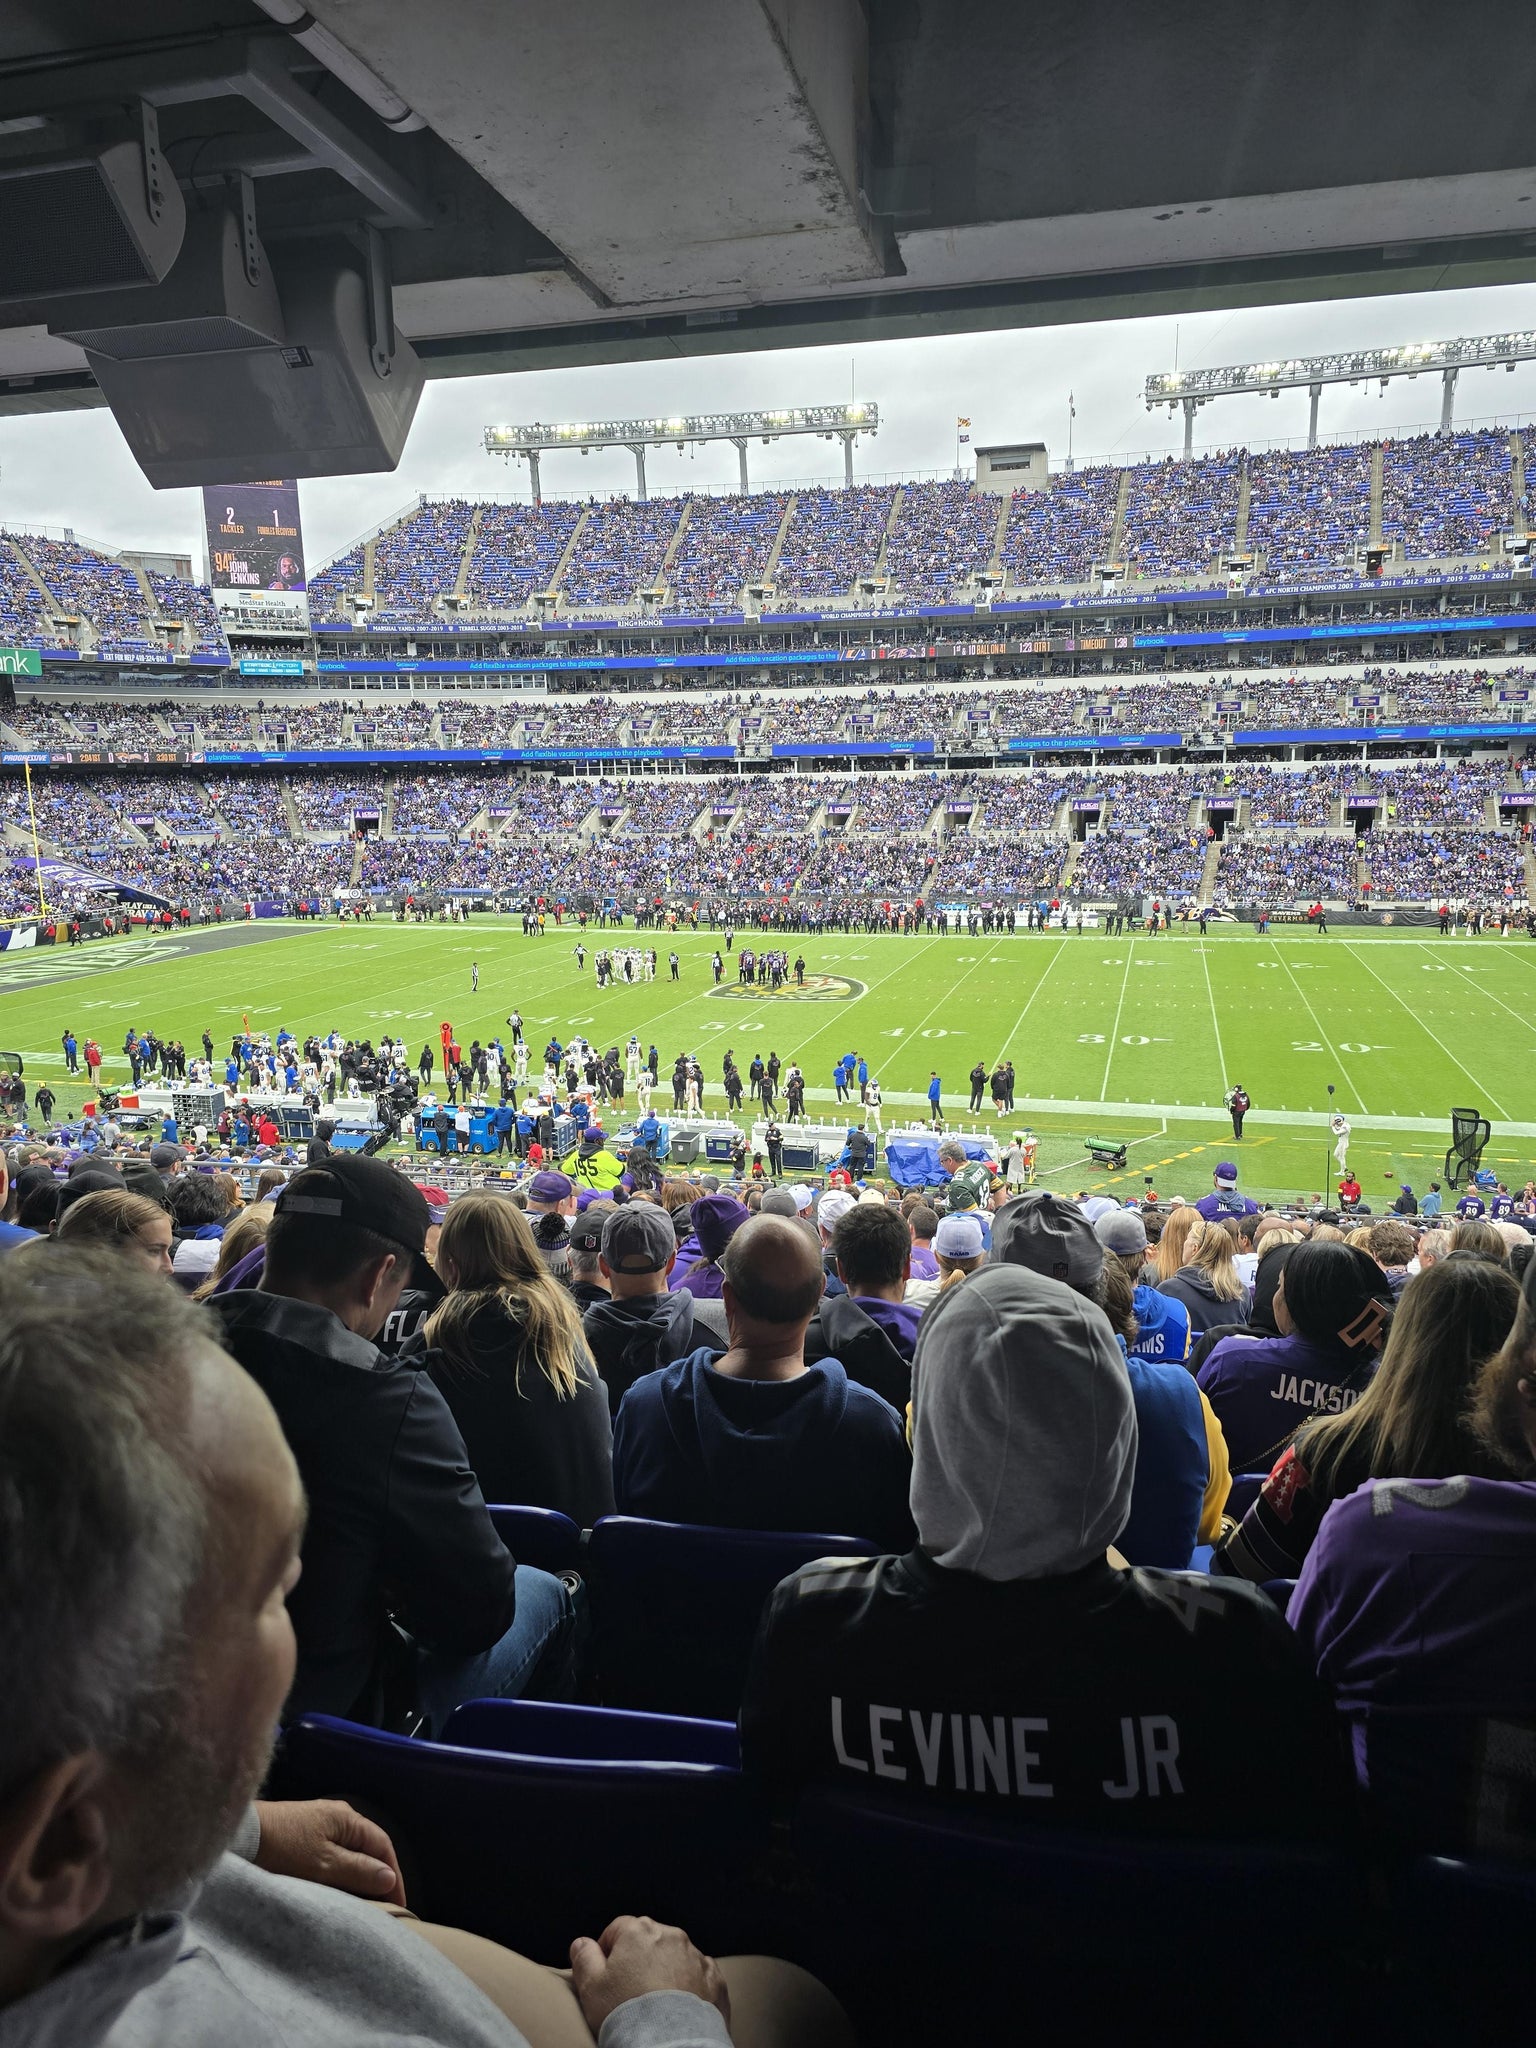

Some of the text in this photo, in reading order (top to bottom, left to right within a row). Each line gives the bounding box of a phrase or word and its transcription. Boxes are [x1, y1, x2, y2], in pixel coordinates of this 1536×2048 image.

[226, 507, 236, 525] 2
[272, 509, 279, 527] 1
[220, 524, 244, 534] TACKLES
[215, 552, 229, 572] 94
[229, 561, 248, 573] JOHN
[230, 573, 260, 584] JENKINS
[1299, 583, 1336, 592] CHAMPIONS
[1338, 582, 1353, 590] 2003
[638, 619, 663, 627] HONOR
[968, 645, 976, 655] 10
[976, 644, 990, 655] BALL
[1080, 639, 1107, 650] TIMEOUT
[483, 661, 506, 669] flexible
[532, 661, 559, 670] packages
[3, 754, 48, 762] PROGRESSIVE
[585, 750, 613, 758] packages
[126, 909, 162, 918] RAVN
[699, 1021, 765, 1032] 50
[879, 1027, 950, 1038] 40
[1076, 1033, 1150, 1045] 30
[628, 1046, 638, 1054] 57
[1290, 1040, 1371, 1053] 20
[1465, 1206, 1478, 1217] 89
[1498, 1205, 1511, 1215] 89
[1270, 1373, 1365, 1413] JACKSO
[831, 1696, 1184, 1799] LEVINE JR
